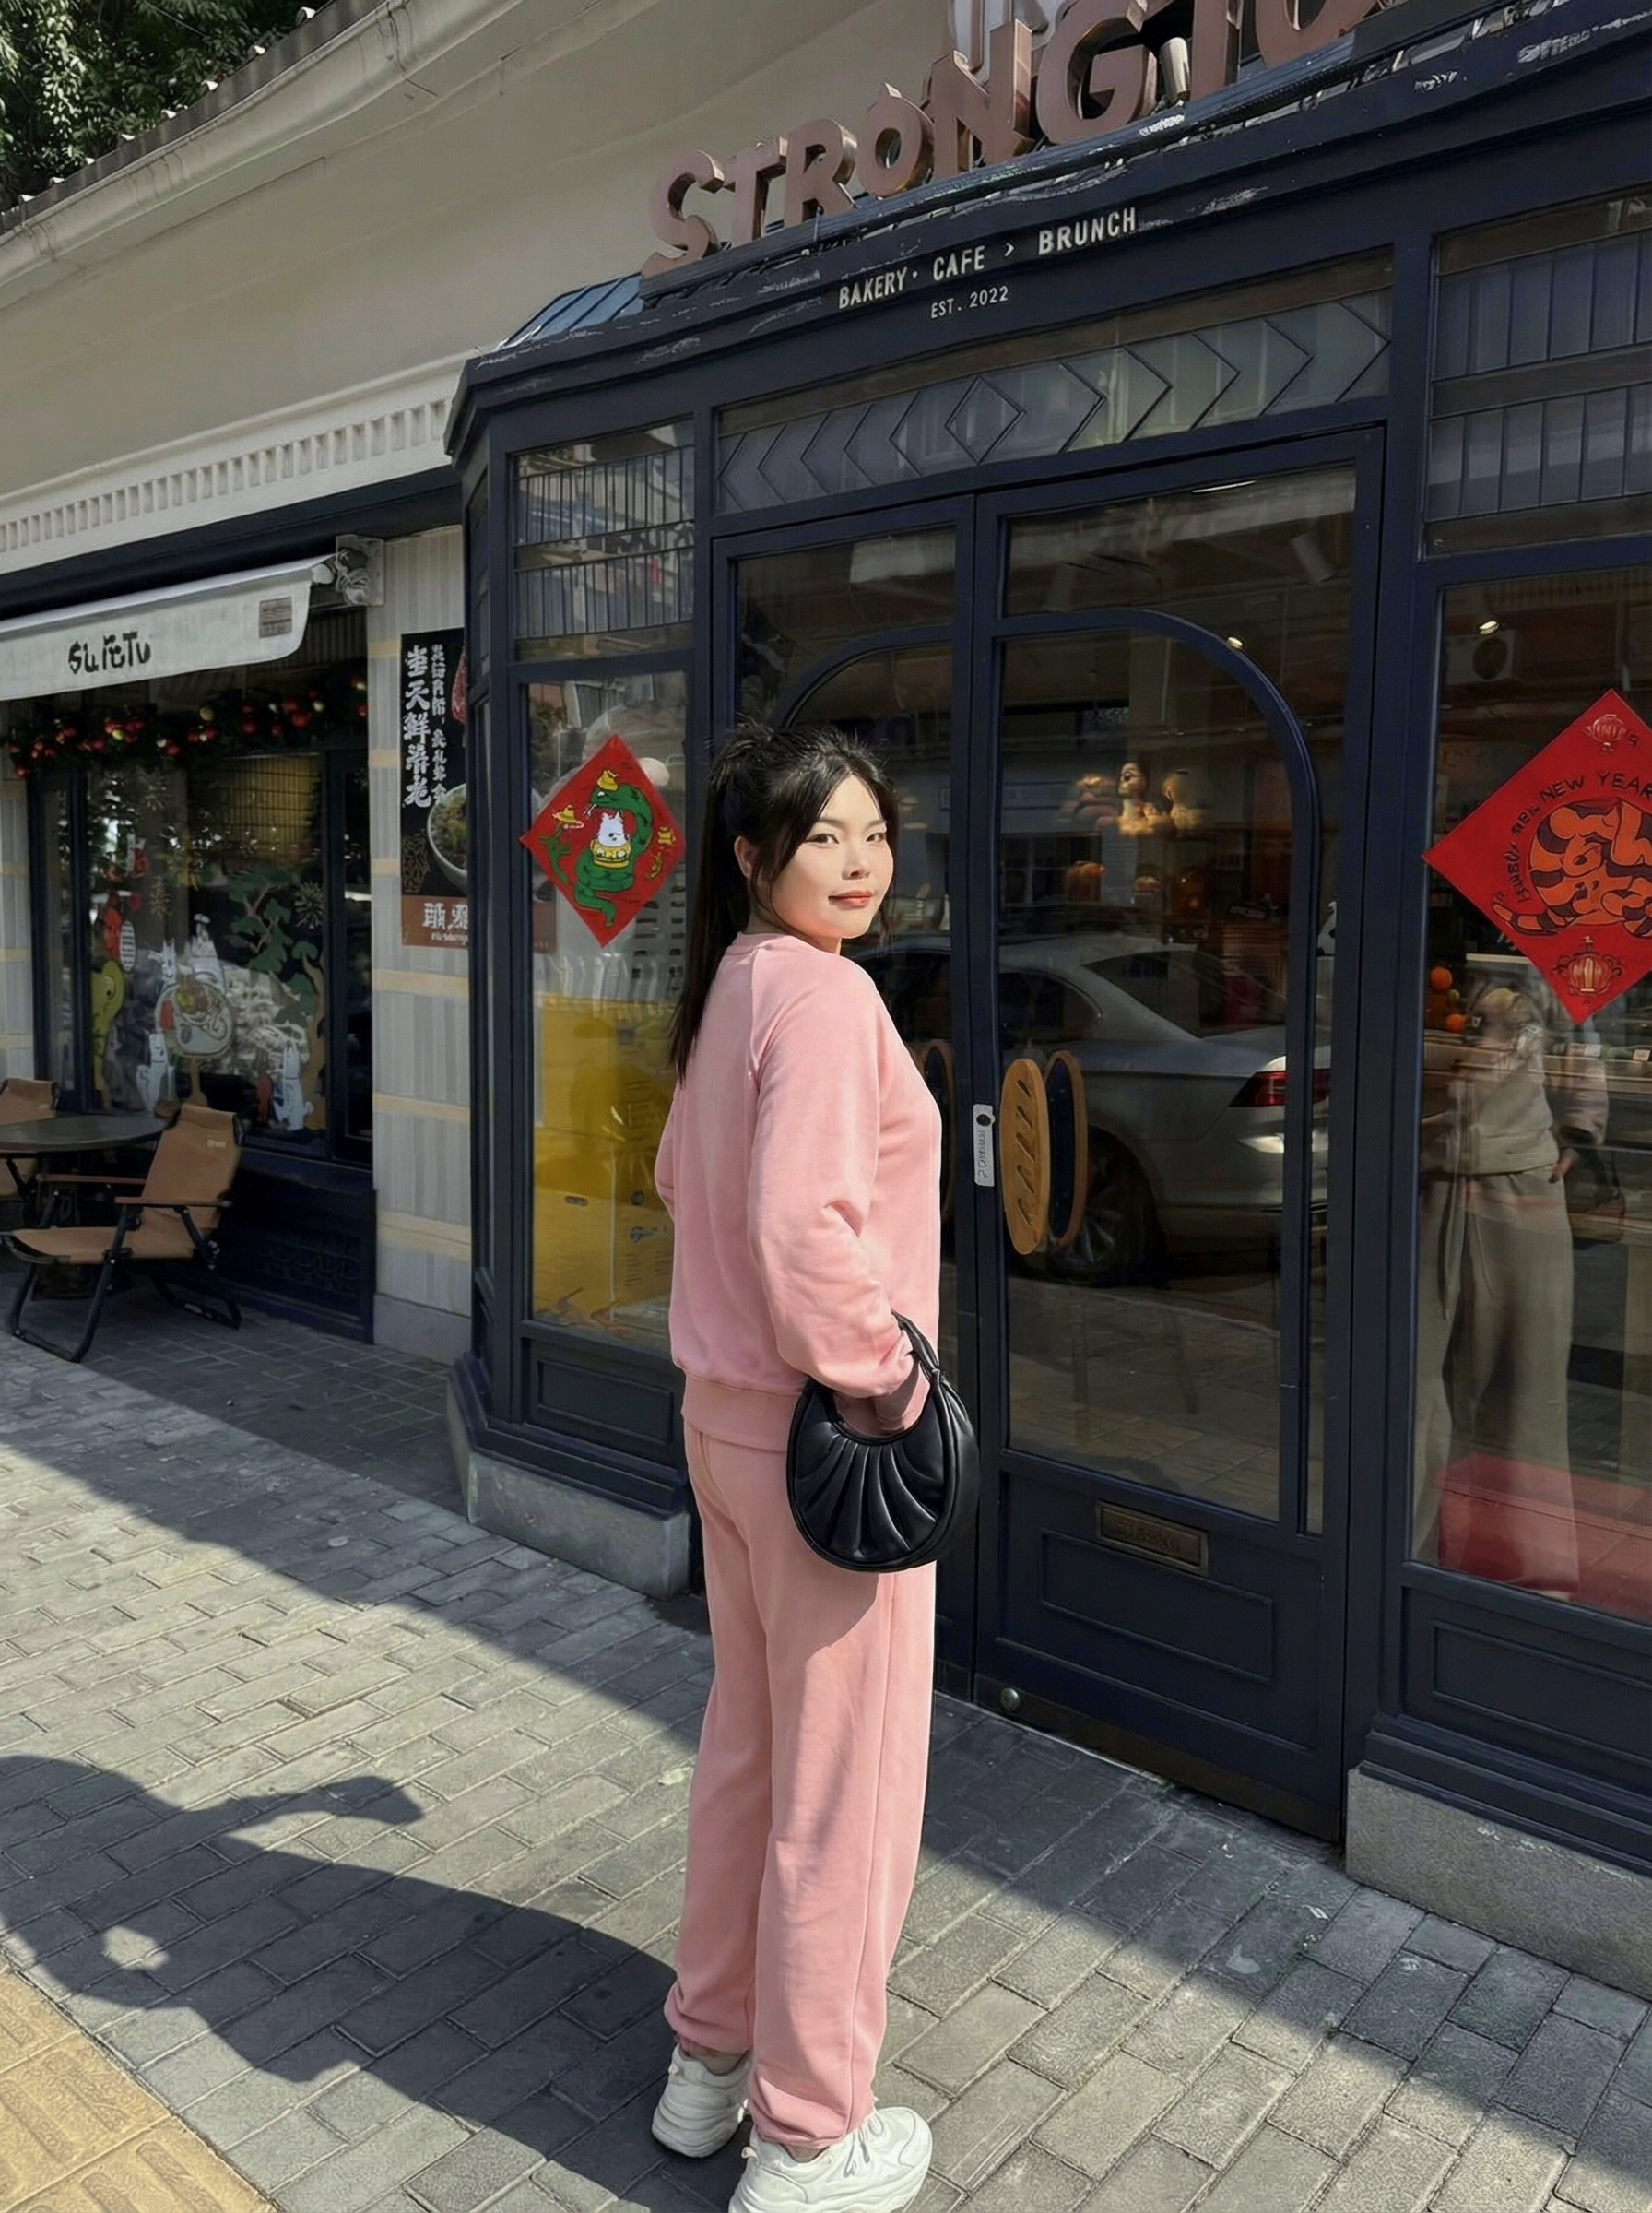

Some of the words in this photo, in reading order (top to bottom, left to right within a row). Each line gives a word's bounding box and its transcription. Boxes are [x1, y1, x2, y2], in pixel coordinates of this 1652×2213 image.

[839, 266, 907, 309] BAKERY
[933, 245, 985, 280] CAFE
[1038, 207, 1137, 255] BRUNCH
[931, 298, 962, 318] EST.
[969, 286, 1009, 308] 2022
[1540, 775, 1585, 801] NEW
[1596, 770, 1652, 801] YEAR
